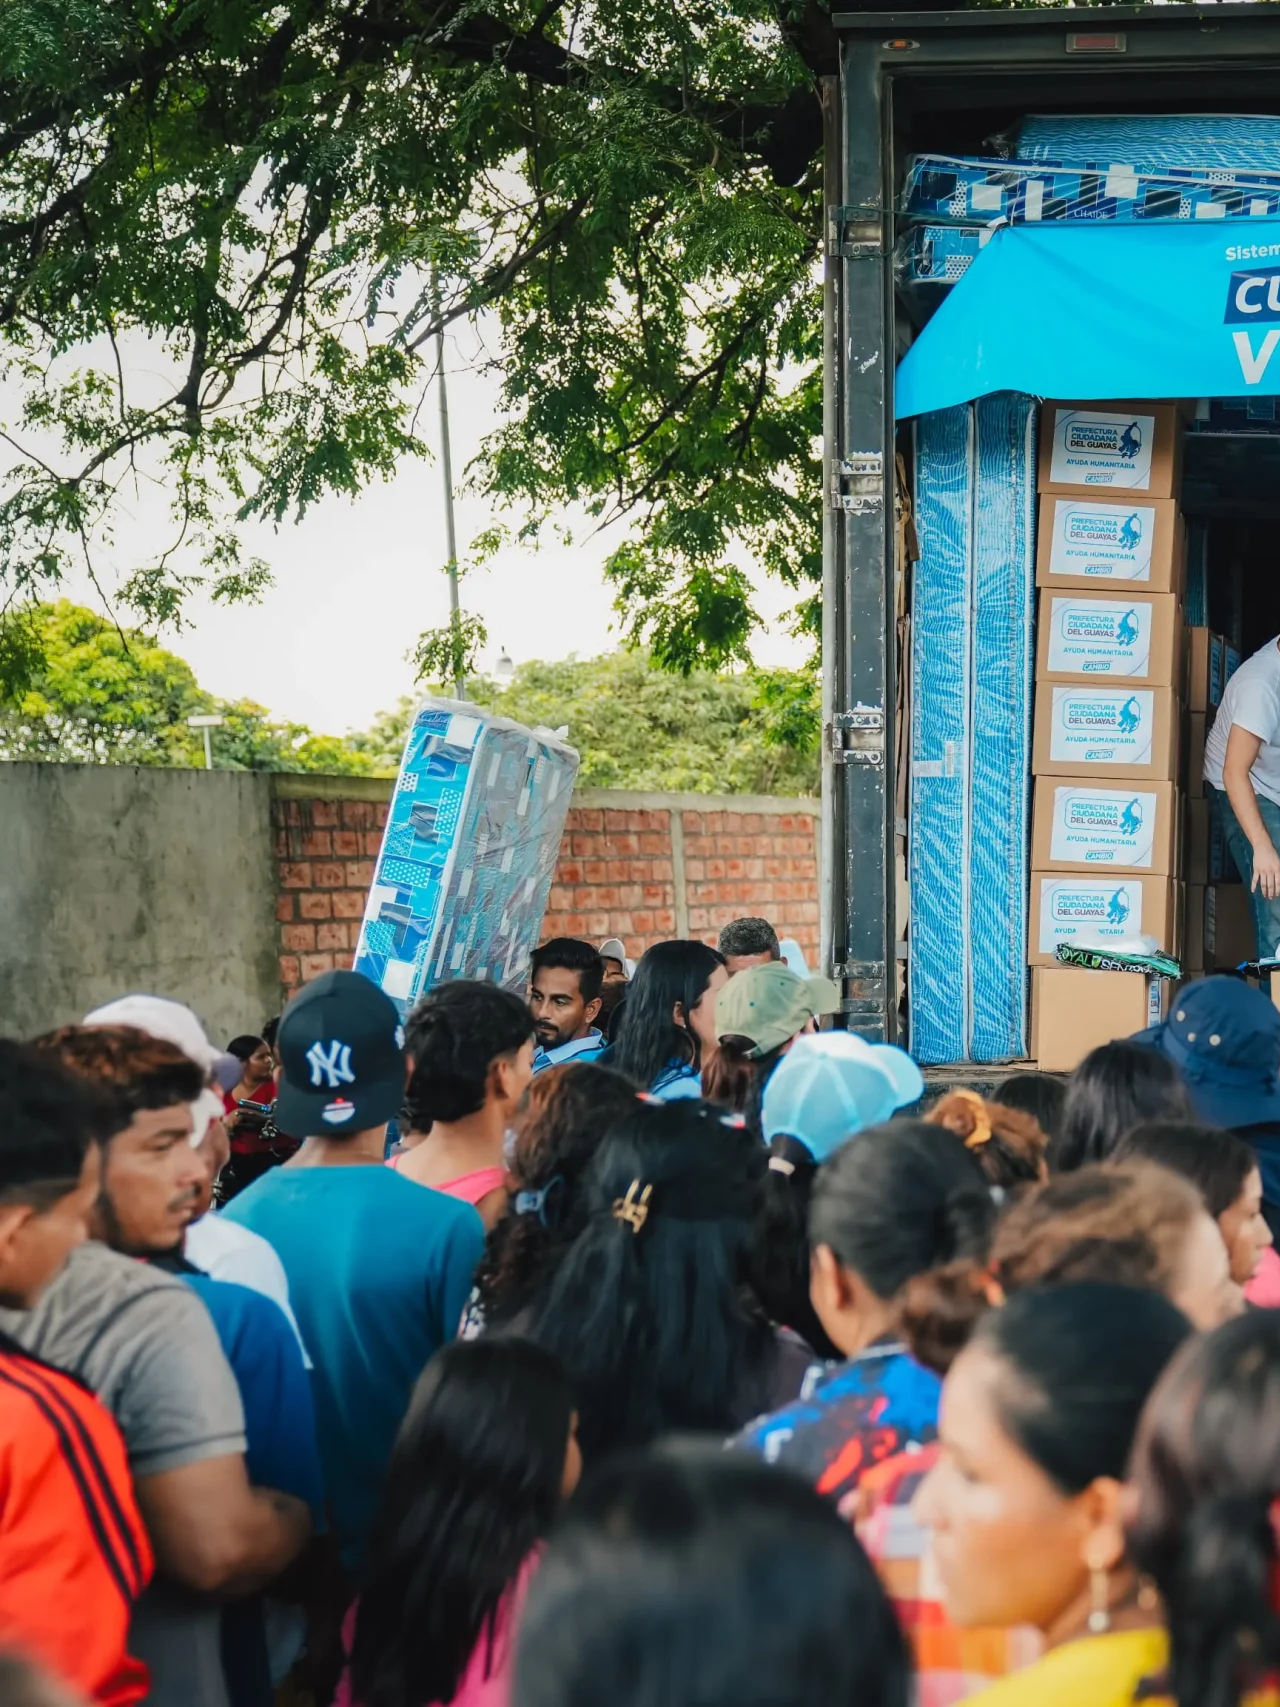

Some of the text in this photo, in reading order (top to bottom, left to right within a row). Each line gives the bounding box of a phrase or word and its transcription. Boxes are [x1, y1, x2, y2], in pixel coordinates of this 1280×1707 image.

[1071, 426, 1118, 436] PREFECTURA
[1071, 433, 1118, 442] CIUDADANA
[1087, 442, 1117, 450] GUAYAS
[1066, 458, 1136, 469] AYUDA HUMANITARIA
[1071, 517, 1118, 526] PREFECTURA
[1070, 524, 1118, 534] CIUDADANA
[1087, 533, 1117, 541] GUAYAS
[1090, 552, 1136, 560] HUMANITARIA
[1068, 614, 1115, 623] PREFECTURA
[1068, 621, 1114, 630] CIUDADANA
[1084, 630, 1114, 638] GUAYAS
[1063, 646, 1133, 656] AYUDA HUMANITARIA
[1069, 710, 1116, 718] CIUDADANA
[1090, 736, 1136, 744] HUMANITARIA
[1072, 803, 1118, 812] PREFECTURA
[1072, 810, 1118, 818] CIUDADANA
[1070, 816, 1118, 826] DEL GUAYAS
[1090, 837, 1137, 846] HUMANITARIA
[1058, 894, 1105, 902] PREFECTURA
[1057, 908, 1073, 916] DEL
[305, 1039, 356, 1088] NY
